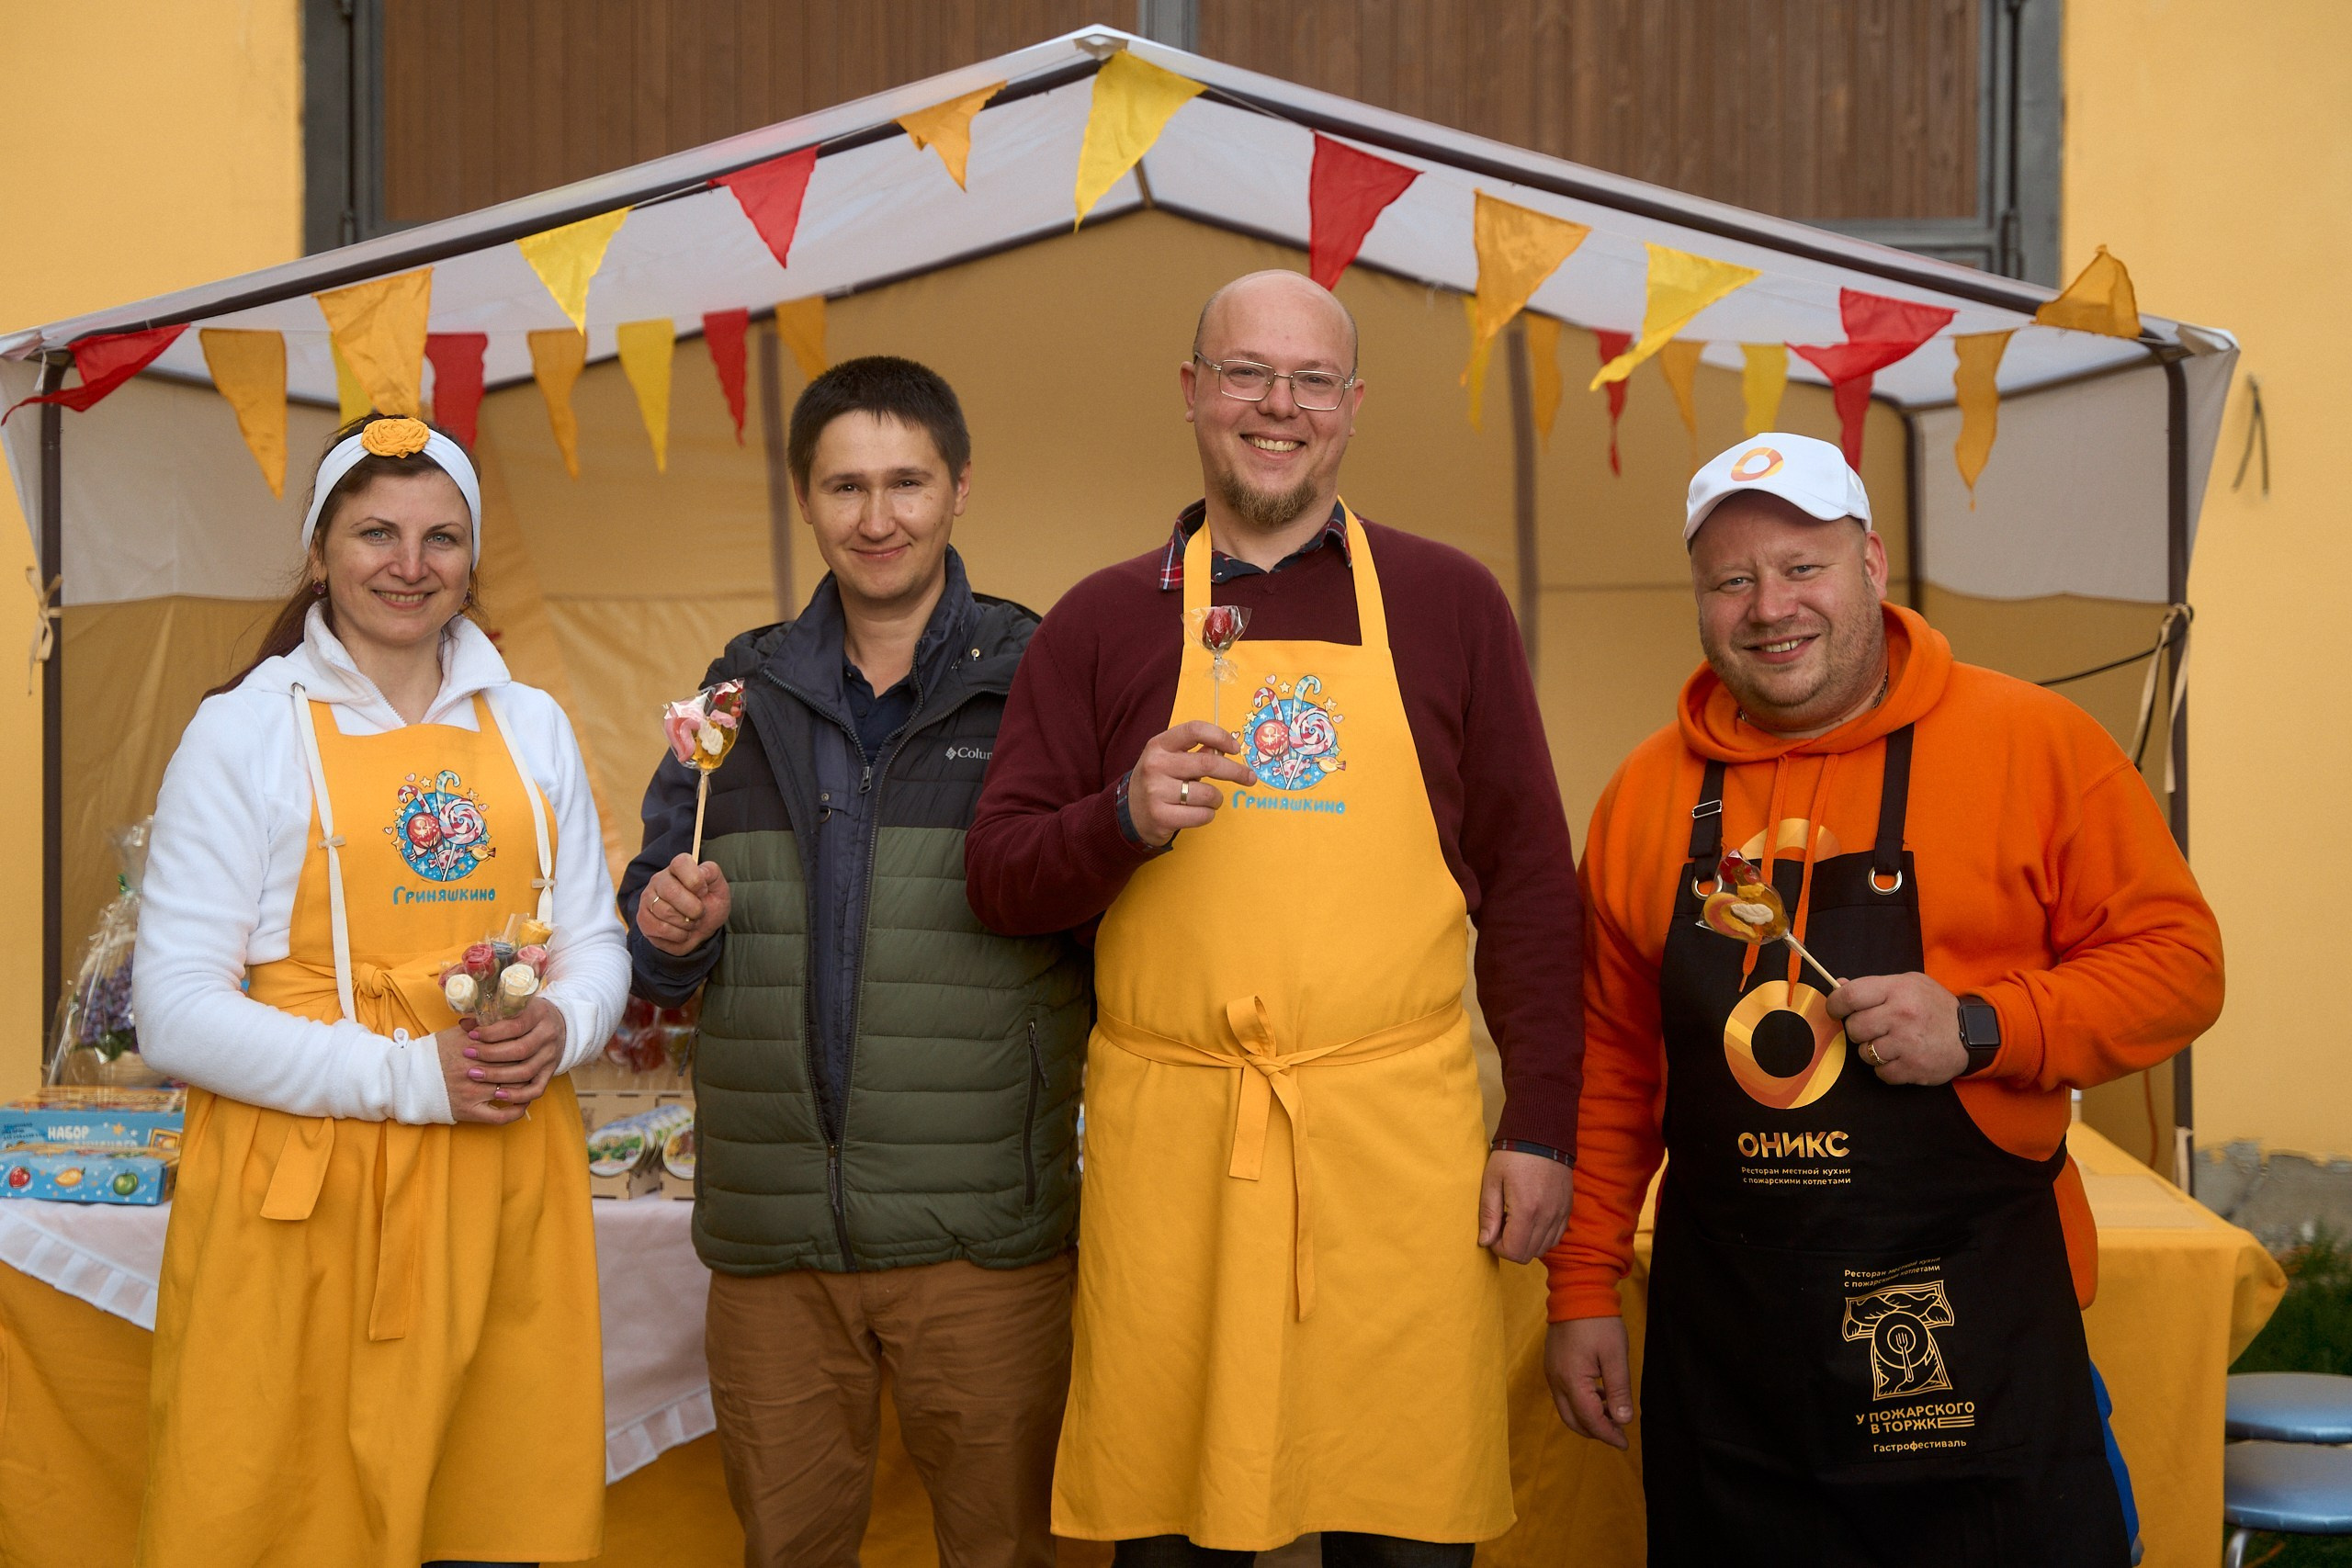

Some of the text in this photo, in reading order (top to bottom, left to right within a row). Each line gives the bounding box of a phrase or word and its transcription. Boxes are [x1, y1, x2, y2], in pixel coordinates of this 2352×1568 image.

[48, 1125, 90, 1140] НАБОР
[1737, 1131, 1850, 1158] ОНИКС
[1741, 1167, 1780, 1176] Ресторан
[1823, 1168, 1851, 1176] кухни
[1844, 1269, 1886, 1279] Ресторан
[1887, 1260, 1918, 1274] местной
[1852, 1273, 1899, 1288] пожарскими
[1900, 1265, 1940, 1276] котлетами
[1856, 1401, 1975, 1425] У ПОЖАРСКОГО
[1871, 1424, 1880, 1434] В
[1873, 1439, 1967, 1452] Гастрофестиваль
